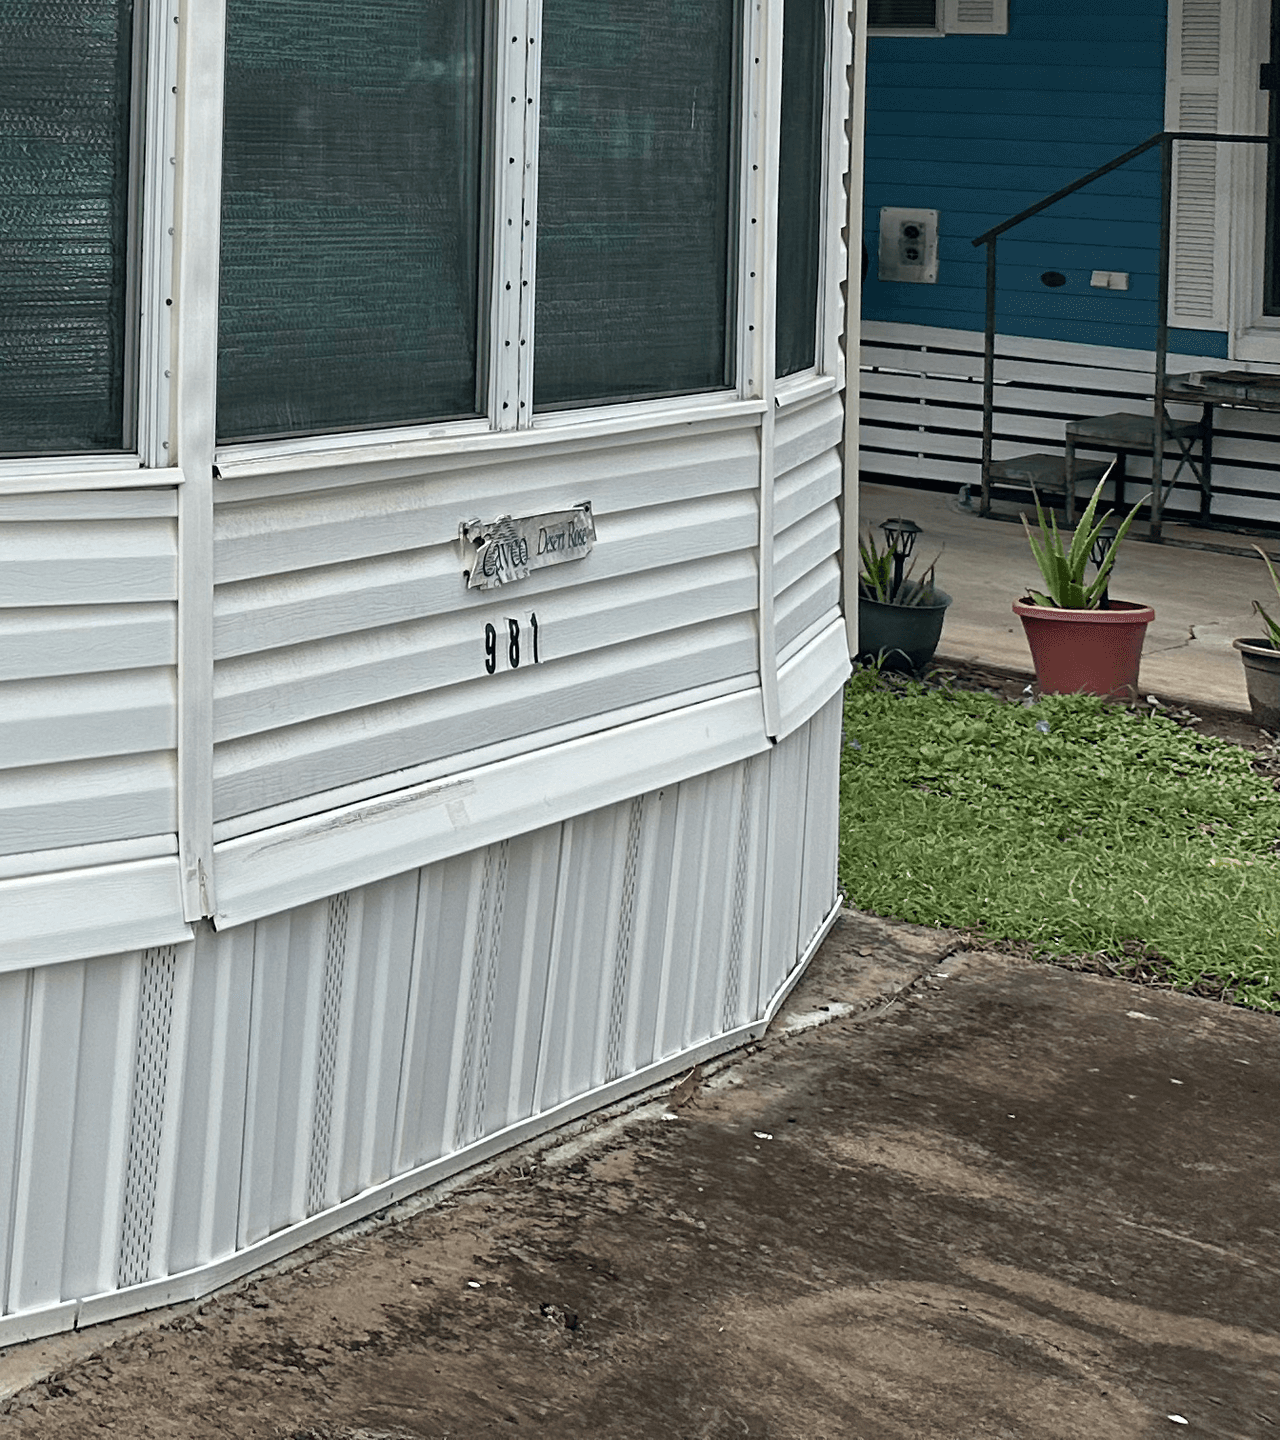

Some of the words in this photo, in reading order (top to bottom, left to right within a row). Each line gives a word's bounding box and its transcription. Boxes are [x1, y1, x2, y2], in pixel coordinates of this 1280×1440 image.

[536, 527, 565, 555] Desert
[568, 520, 587, 549] Rose
[484, 612, 539, 674] 981
